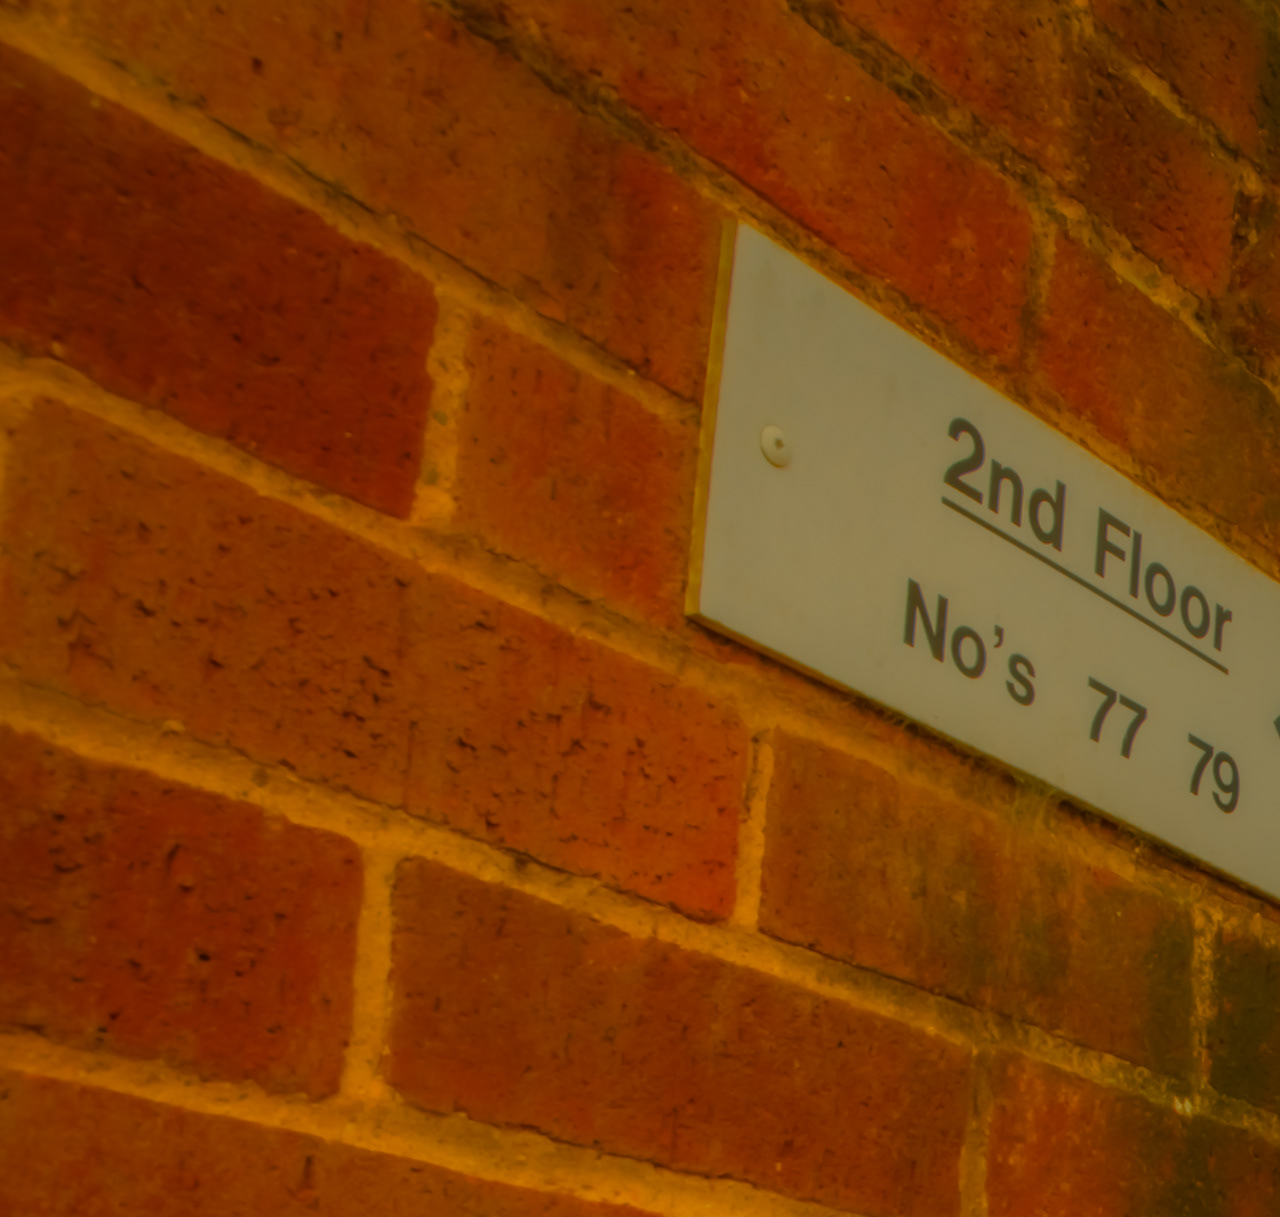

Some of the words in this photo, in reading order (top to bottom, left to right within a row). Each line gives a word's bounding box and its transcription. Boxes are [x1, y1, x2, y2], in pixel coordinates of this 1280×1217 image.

[943, 416, 1067, 553] 2nd
[1094, 507, 1233, 653] Floor
[903, 577, 1036, 707] No's
[1087, 676, 1148, 760] 77
[1187, 732, 1241, 815] 79
